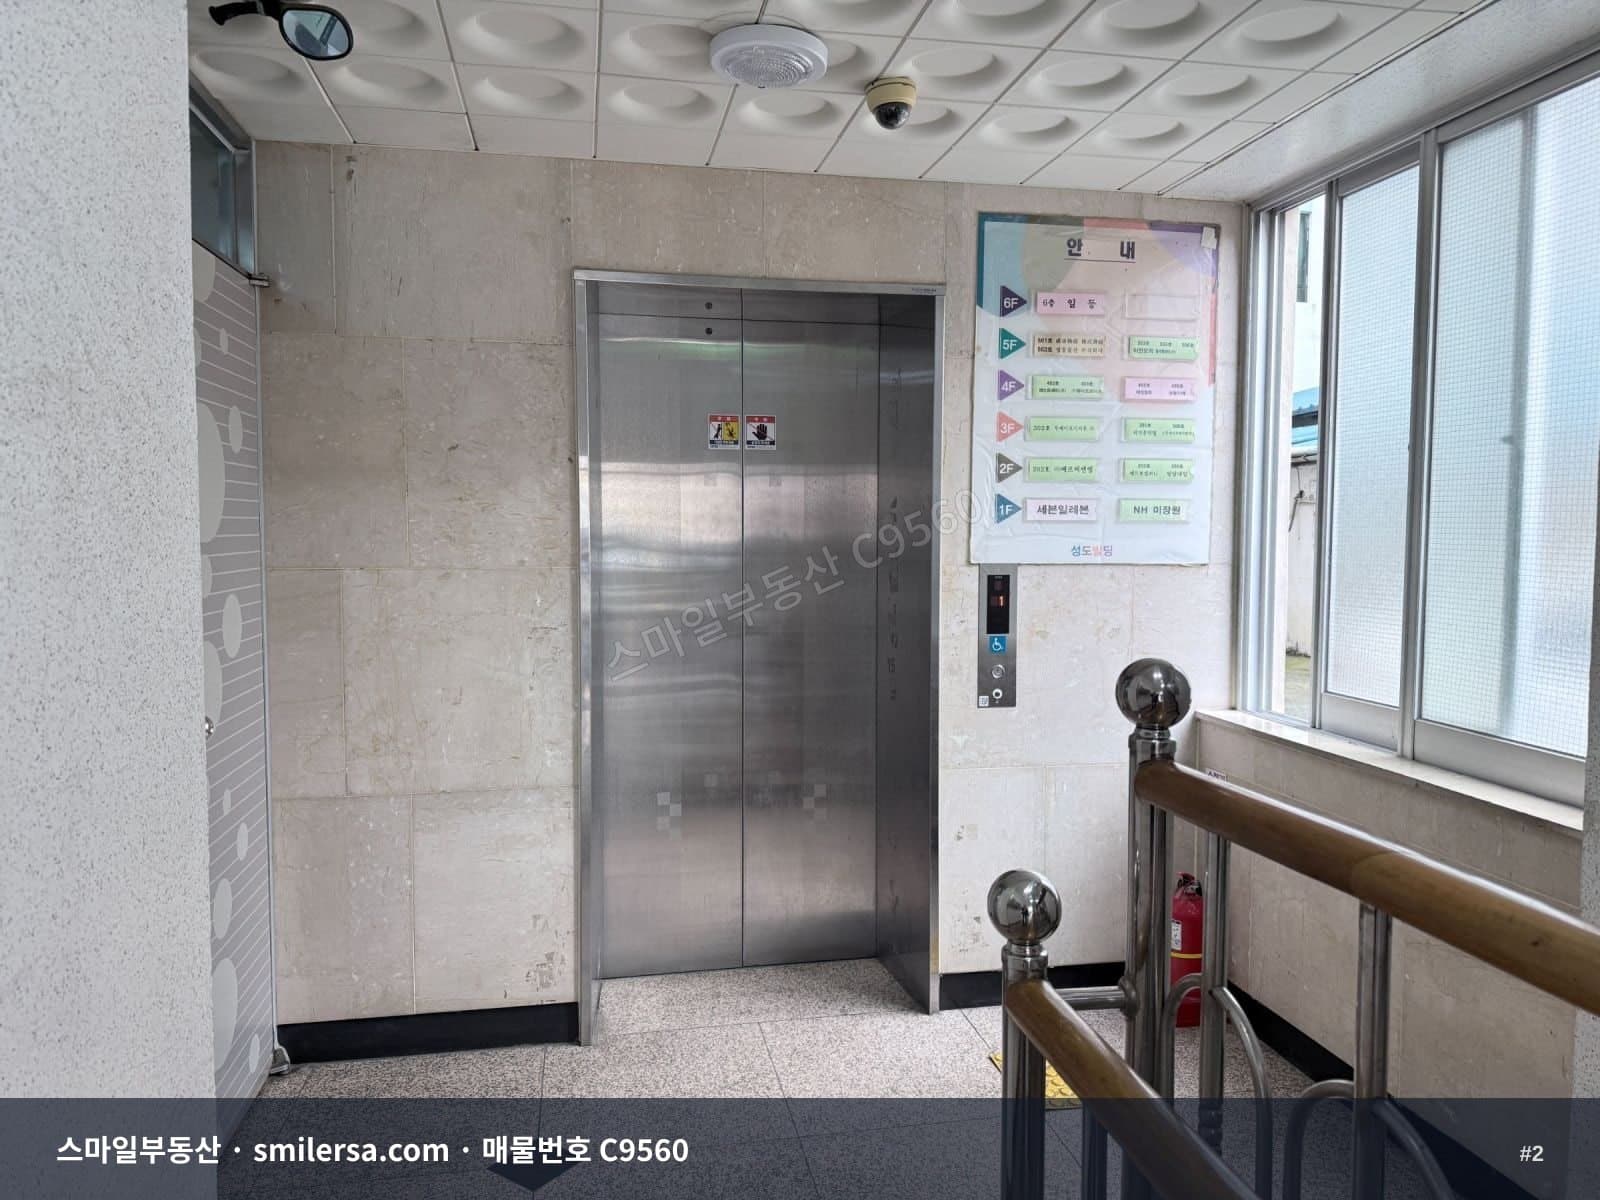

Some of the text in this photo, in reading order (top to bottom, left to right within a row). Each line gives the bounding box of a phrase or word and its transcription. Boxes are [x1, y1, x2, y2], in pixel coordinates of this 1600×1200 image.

[1066, 238, 1136, 260] 안 내
[1003, 297, 1019, 310] 6F
[1002, 338, 1017, 352] 5F
[1001, 381, 1016, 393] 4F
[1000, 423, 1015, 435] 3F
[999, 463, 1014, 475] 2F
[999, 504, 1013, 516] 1F
[1037, 504, 1090, 516] 세븐일레븐
[1133, 505, 1181, 516] NH 미장원
